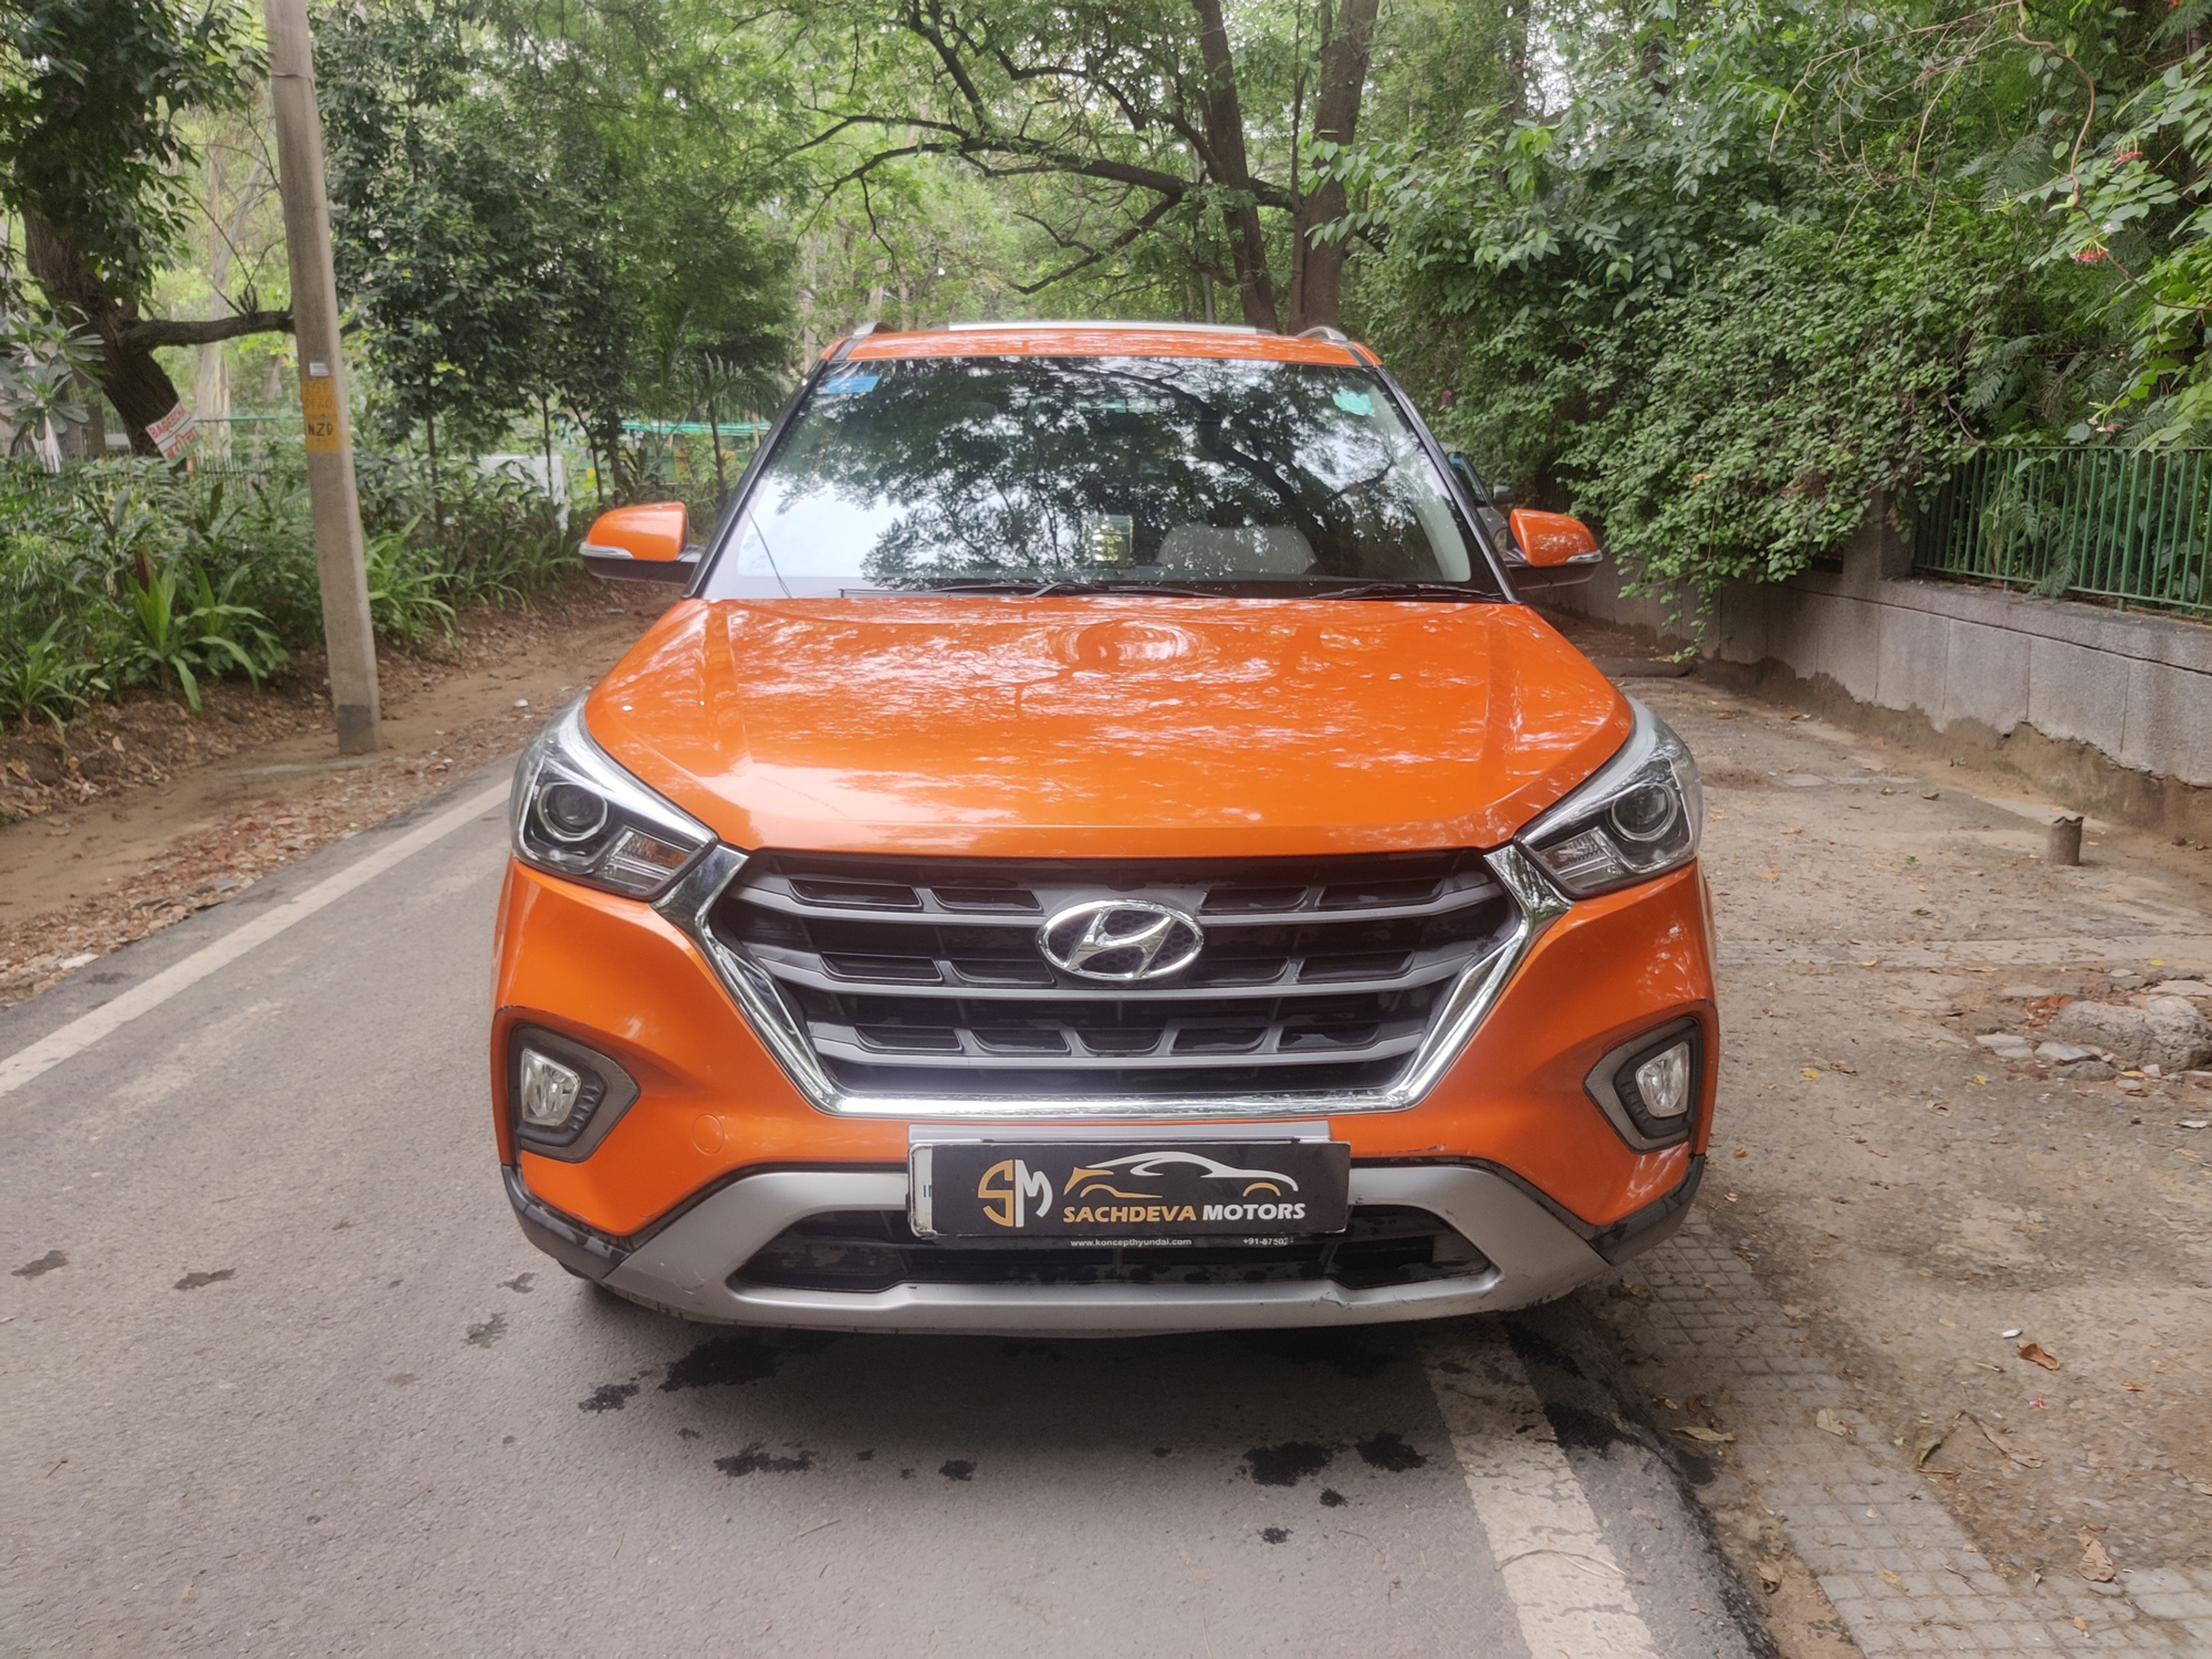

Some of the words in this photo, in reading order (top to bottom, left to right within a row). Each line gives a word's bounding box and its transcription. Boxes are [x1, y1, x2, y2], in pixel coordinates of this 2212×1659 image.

[978, 1159, 1053, 1227] SM
[1063, 1206, 1196, 1223] SACHDEVA
[1202, 1203, 1306, 1221] MOTORS
[1071, 1238, 1192, 1248] www.koncepthyundai.com
